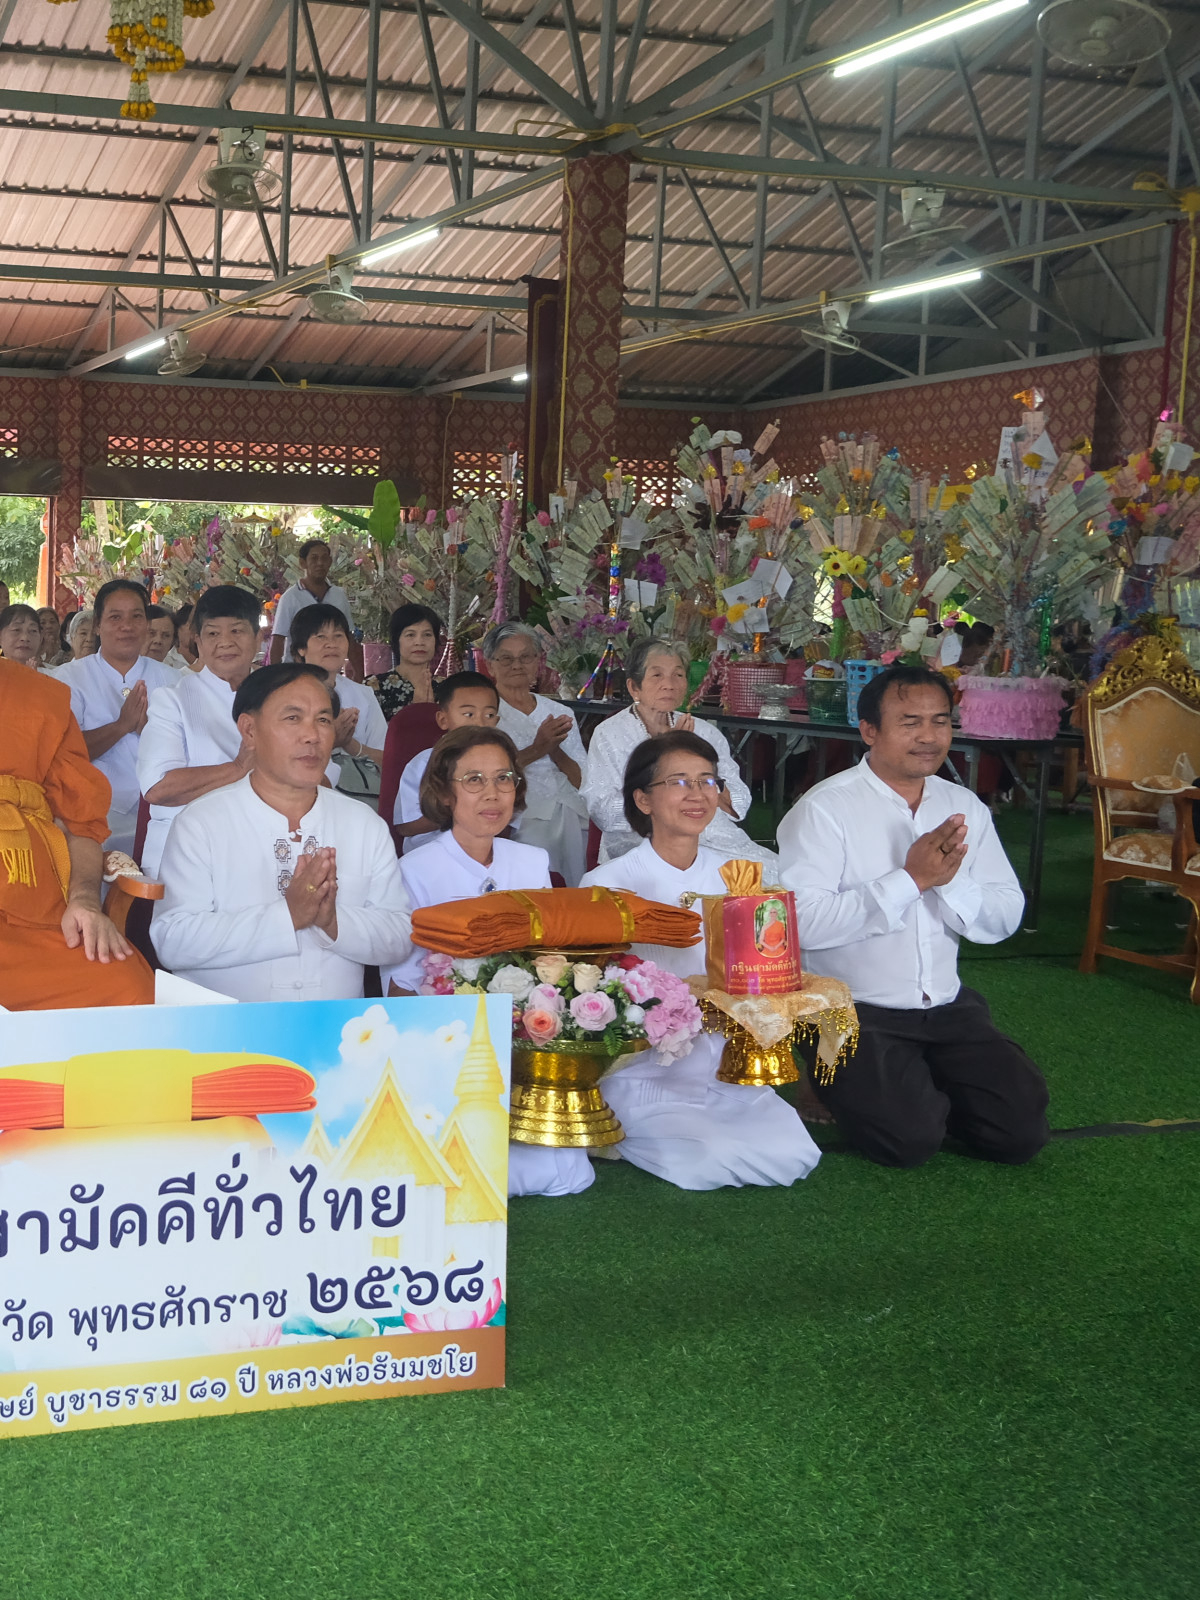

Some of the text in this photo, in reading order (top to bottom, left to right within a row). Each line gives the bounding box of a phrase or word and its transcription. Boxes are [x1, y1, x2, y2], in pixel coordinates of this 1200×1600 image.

[2, 1299, 54, 1342] วัด
[68, 1285, 288, 1351] พุทธศักราช
[307, 1259, 485, 1314] ๒๕๖๘
[47, 1383, 178, 1423] บูชาธรรม
[189, 1380, 227, 1399] ๘๑
[239, 1366, 256, 1393] ปี
[268, 1347, 474, 1391] หลวงพ่อธัมมชโย
